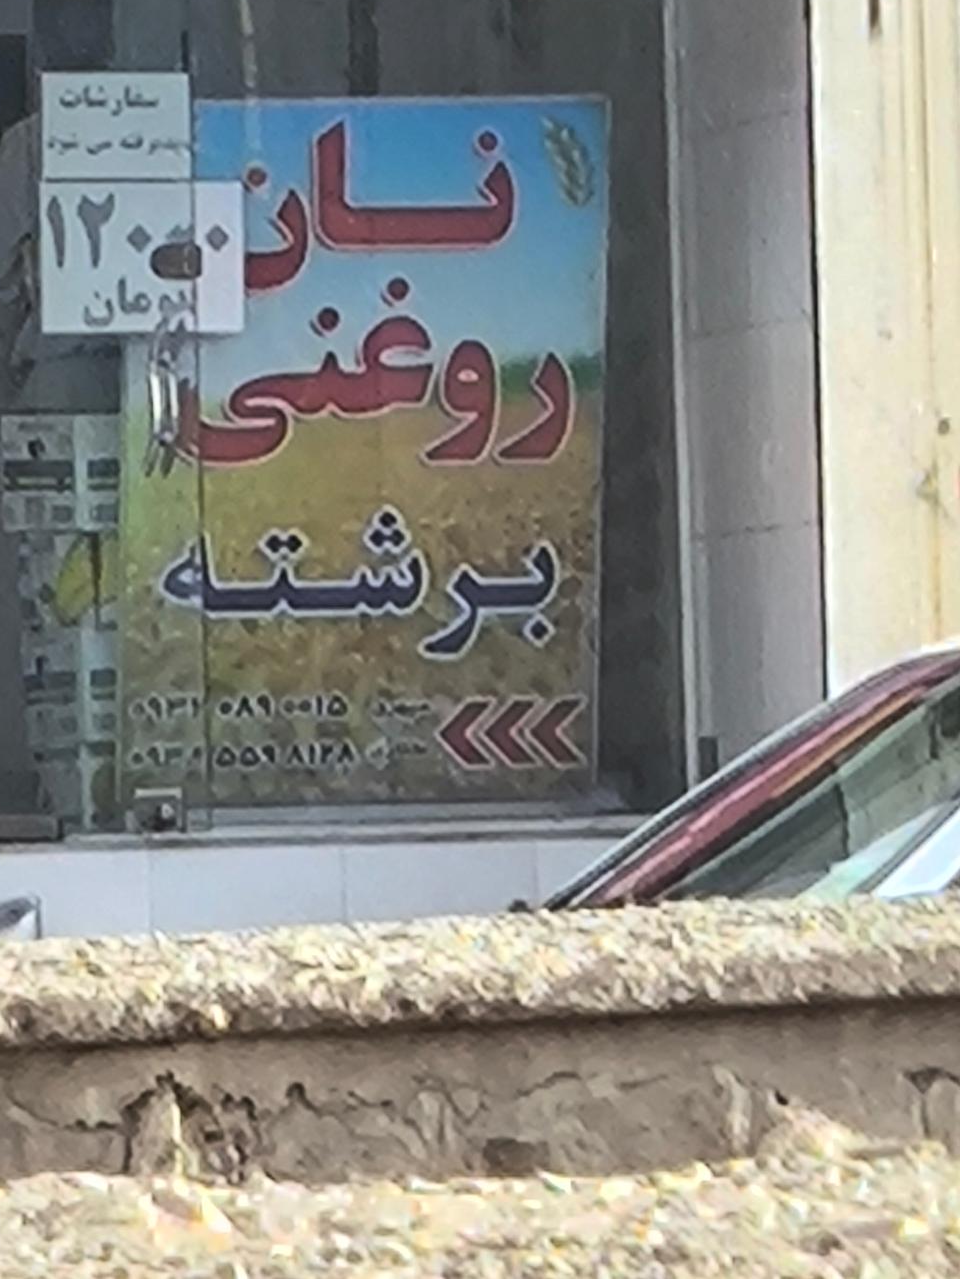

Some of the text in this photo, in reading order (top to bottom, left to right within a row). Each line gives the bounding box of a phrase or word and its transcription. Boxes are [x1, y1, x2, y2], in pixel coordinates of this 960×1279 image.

[58, 84, 160, 117] سفارشات
[176, 276, 575, 467] روغنی
[160, 504, 562, 659] برشته
